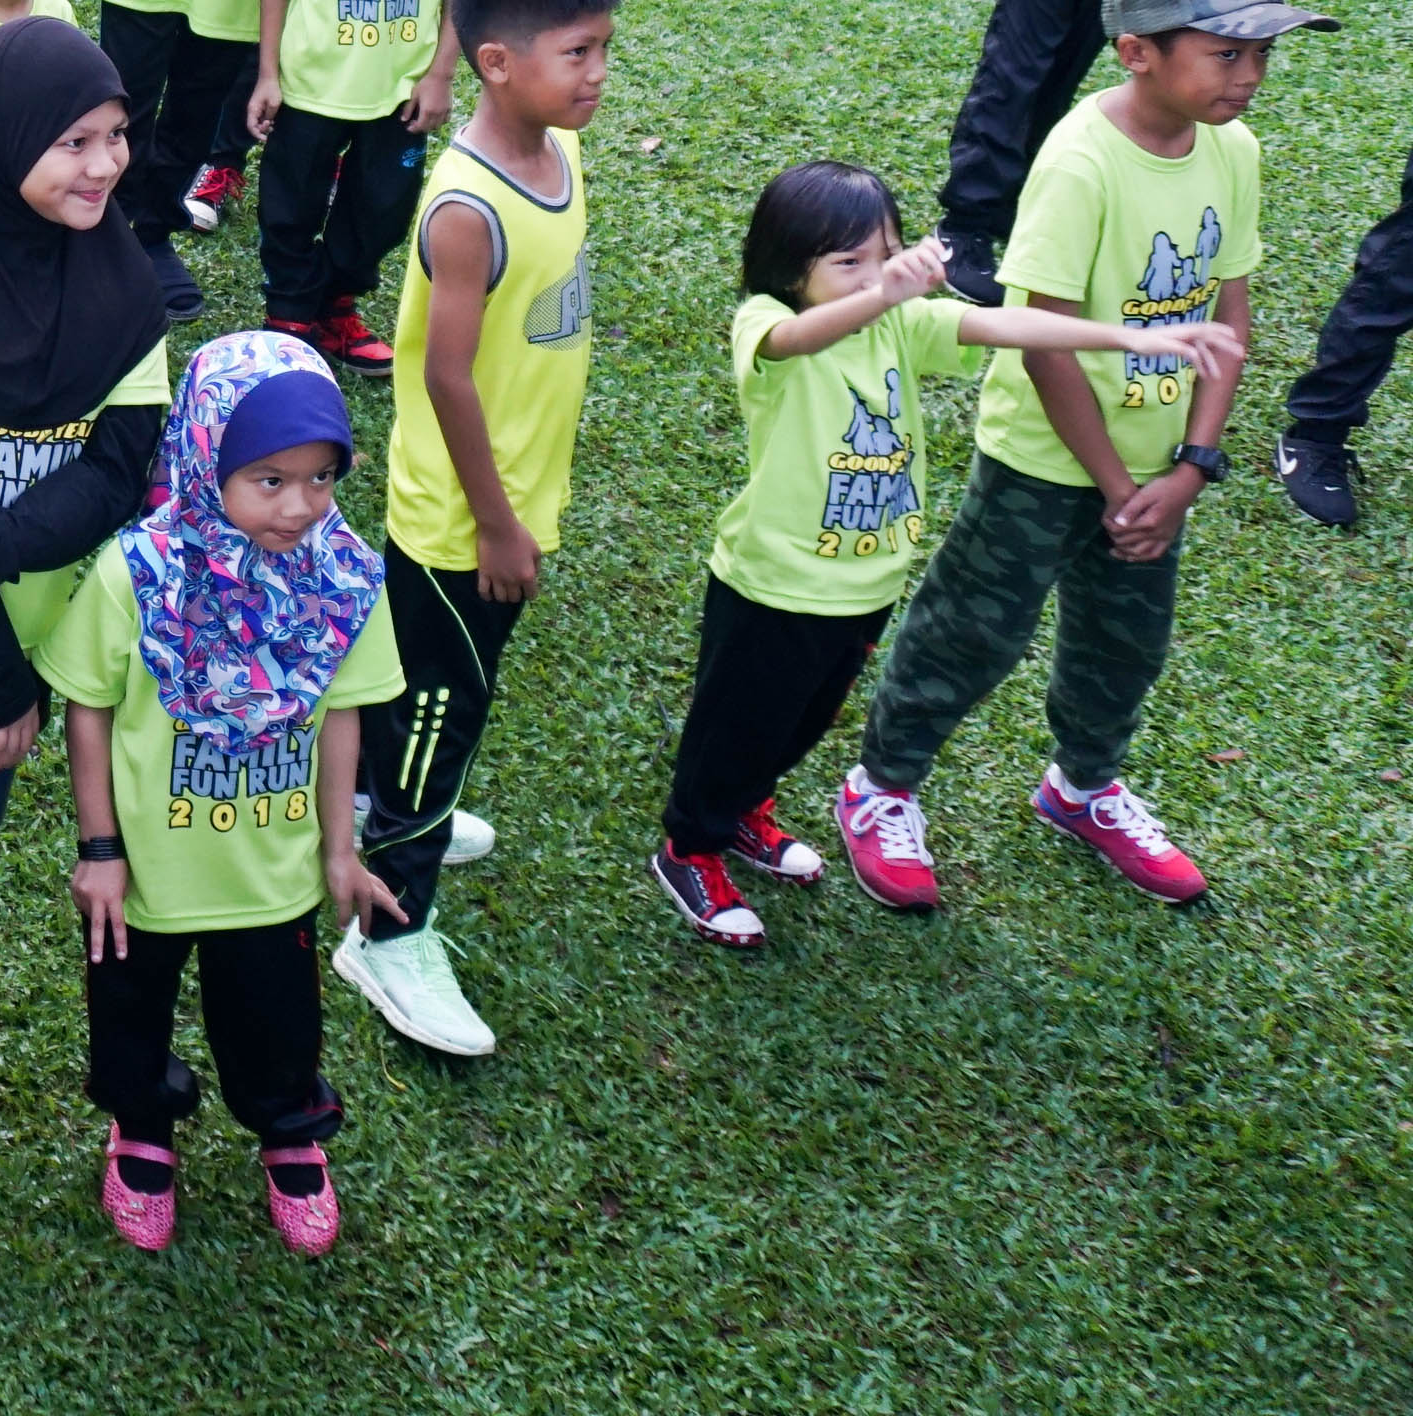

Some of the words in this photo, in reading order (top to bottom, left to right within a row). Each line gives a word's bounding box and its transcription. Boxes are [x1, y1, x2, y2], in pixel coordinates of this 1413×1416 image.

[822, 503, 886, 532] FUN
[170, 766, 239, 801] FUN
[246, 758, 310, 798] RUN
[169, 790, 308, 833] 2018
